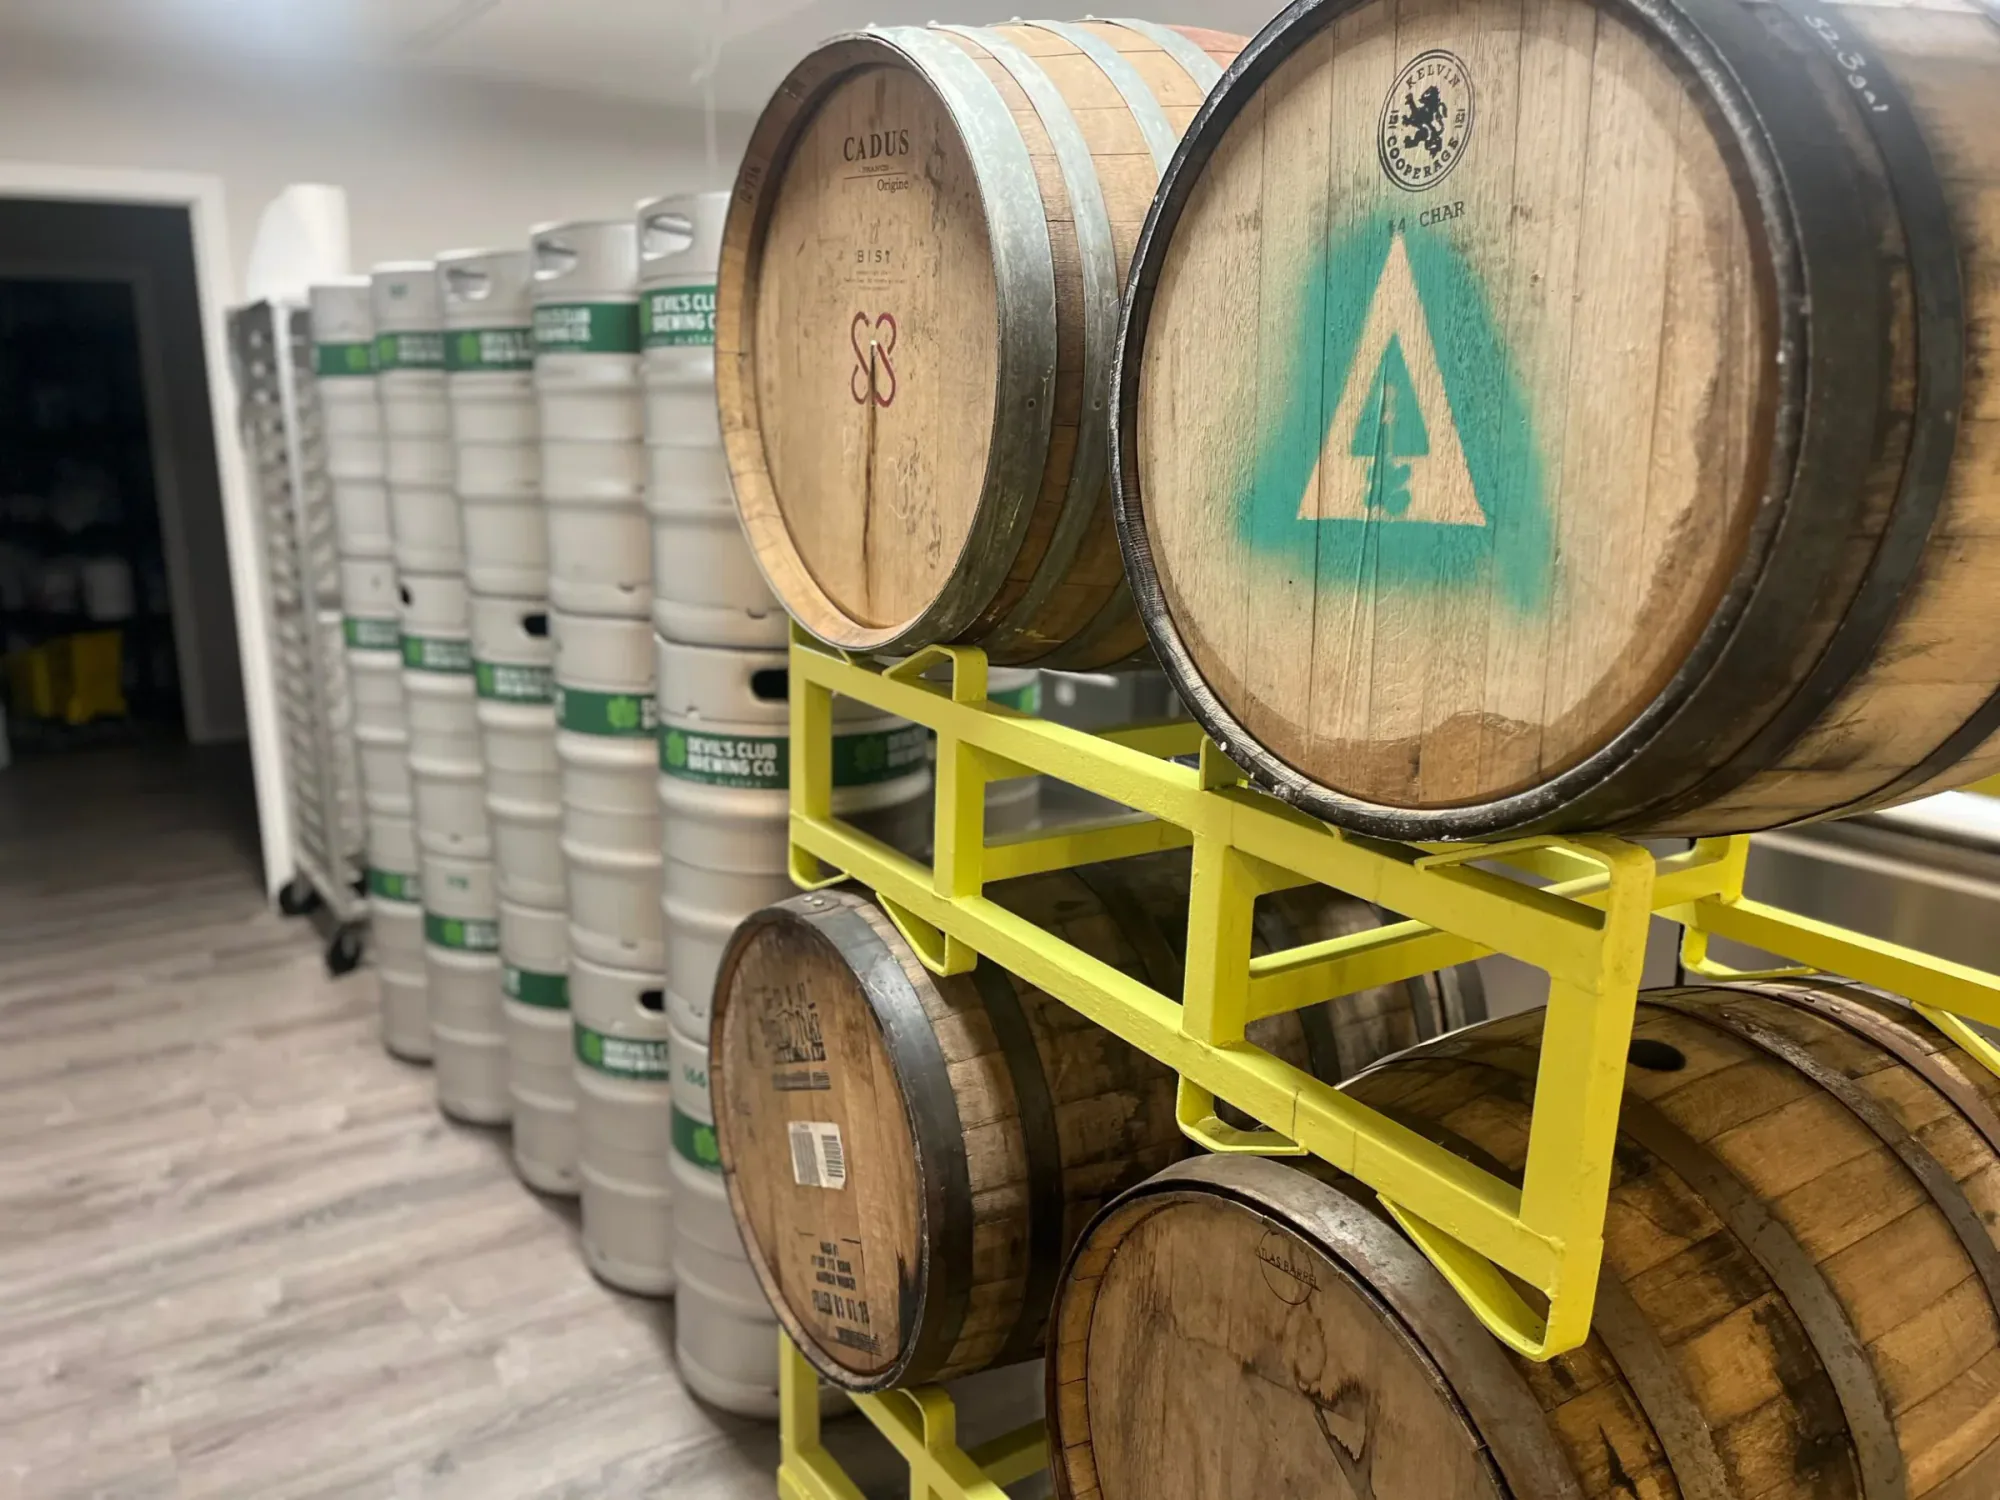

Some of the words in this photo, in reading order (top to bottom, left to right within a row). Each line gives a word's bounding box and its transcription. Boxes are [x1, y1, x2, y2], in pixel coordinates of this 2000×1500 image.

[1405, 63, 1461, 89] KELVIN
[843, 129, 909, 162] CADUS
[1386, 134, 1460, 180] COOPERAGE
[877, 178, 909, 193] Origine
[1420, 201, 1465, 227] CHAR
[686, 735, 735, 758] DEVIL'S
[736, 742, 778, 760] CLUB
[686, 754, 751, 776] BREWING
[752, 760, 779, 776] CO.
[1283, 1260, 1318, 1289] BARREL
